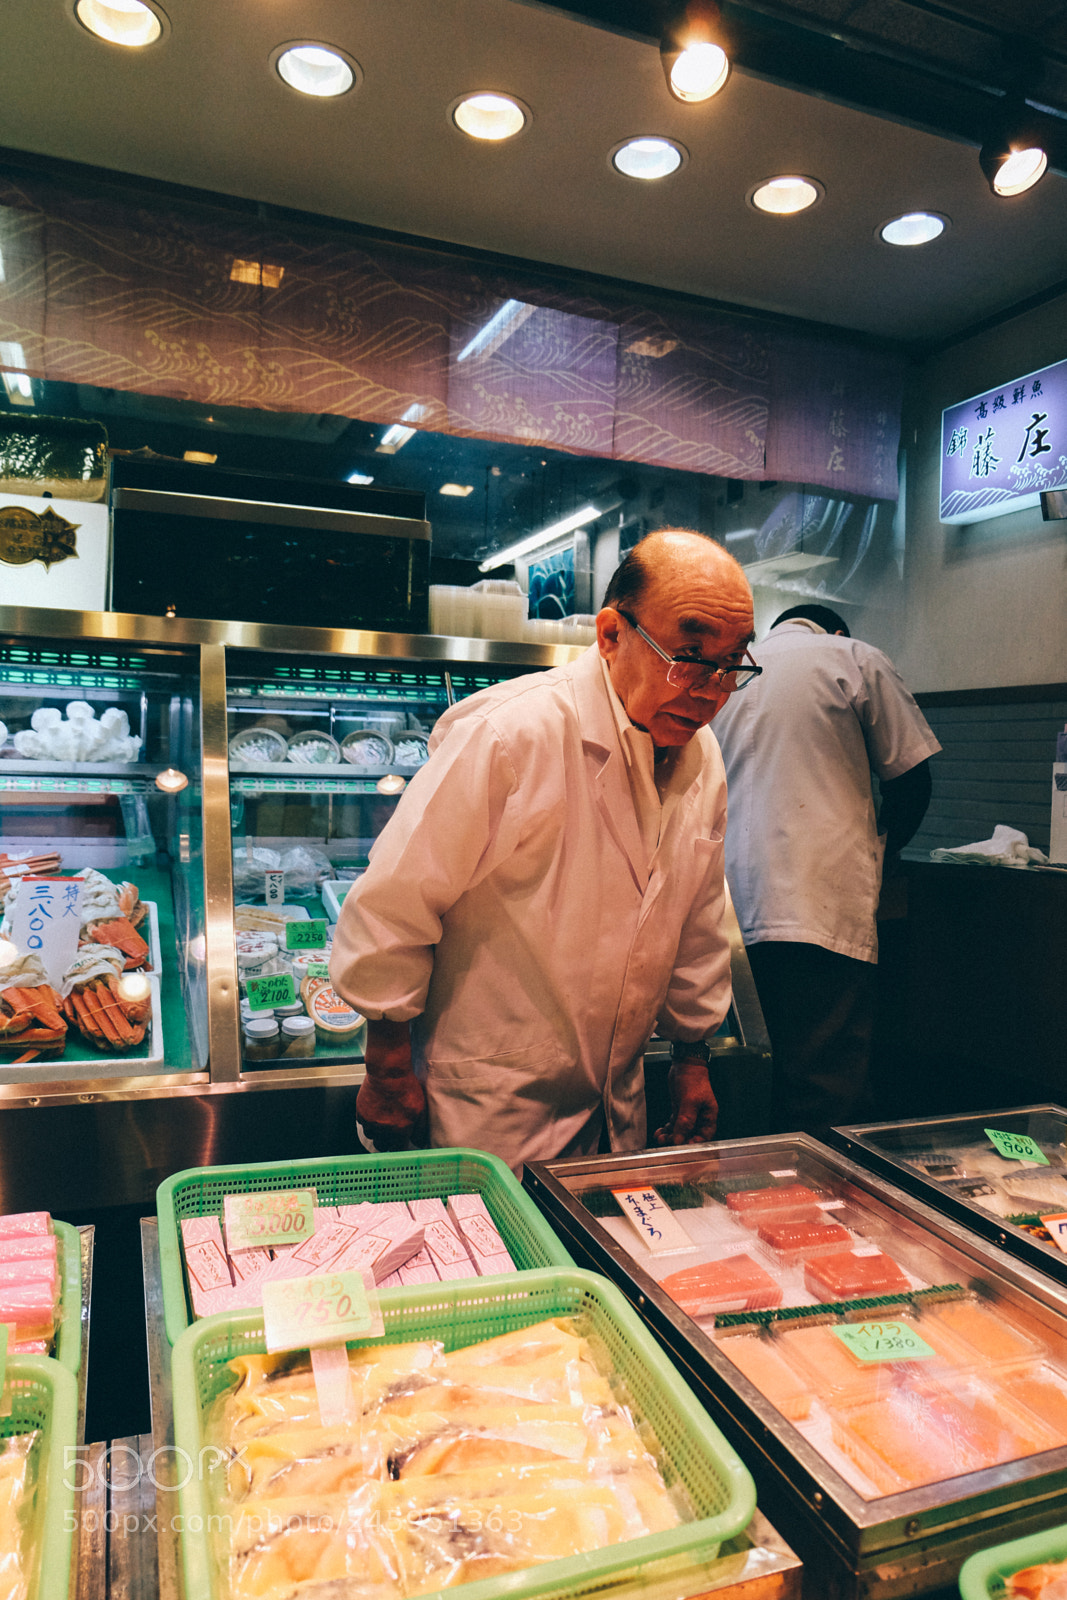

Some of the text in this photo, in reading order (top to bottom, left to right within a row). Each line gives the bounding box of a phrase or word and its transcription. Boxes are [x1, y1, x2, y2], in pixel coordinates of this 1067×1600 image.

[974, 380, 1044, 420] 高級鮮魚
[62, 883, 80, 917] 特大
[857, 1323, 902, 1337] イクラ
